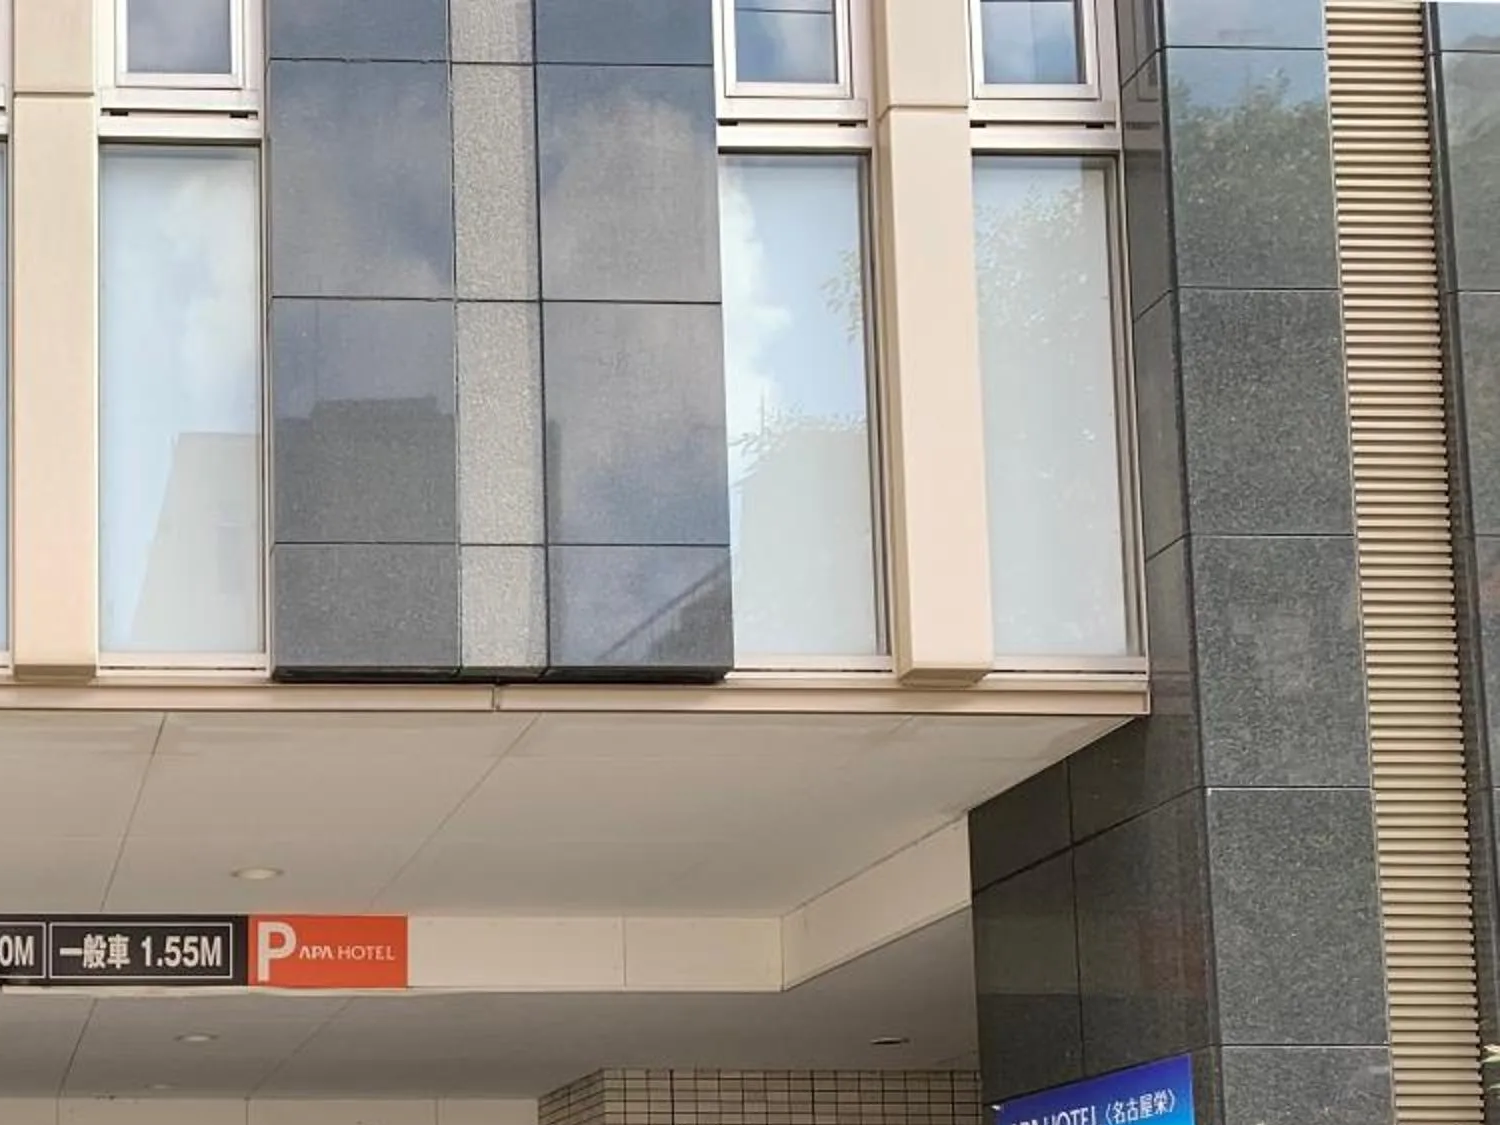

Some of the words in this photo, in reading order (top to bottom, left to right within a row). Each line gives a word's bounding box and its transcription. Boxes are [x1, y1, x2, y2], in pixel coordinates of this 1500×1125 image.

[59, 933, 131, 969] 一般車
[140, 935, 222, 968] 1.55M
[256, 921, 297, 982] P
[298, 944, 335, 959] APA
[337, 945, 396, 960] HOTEL
